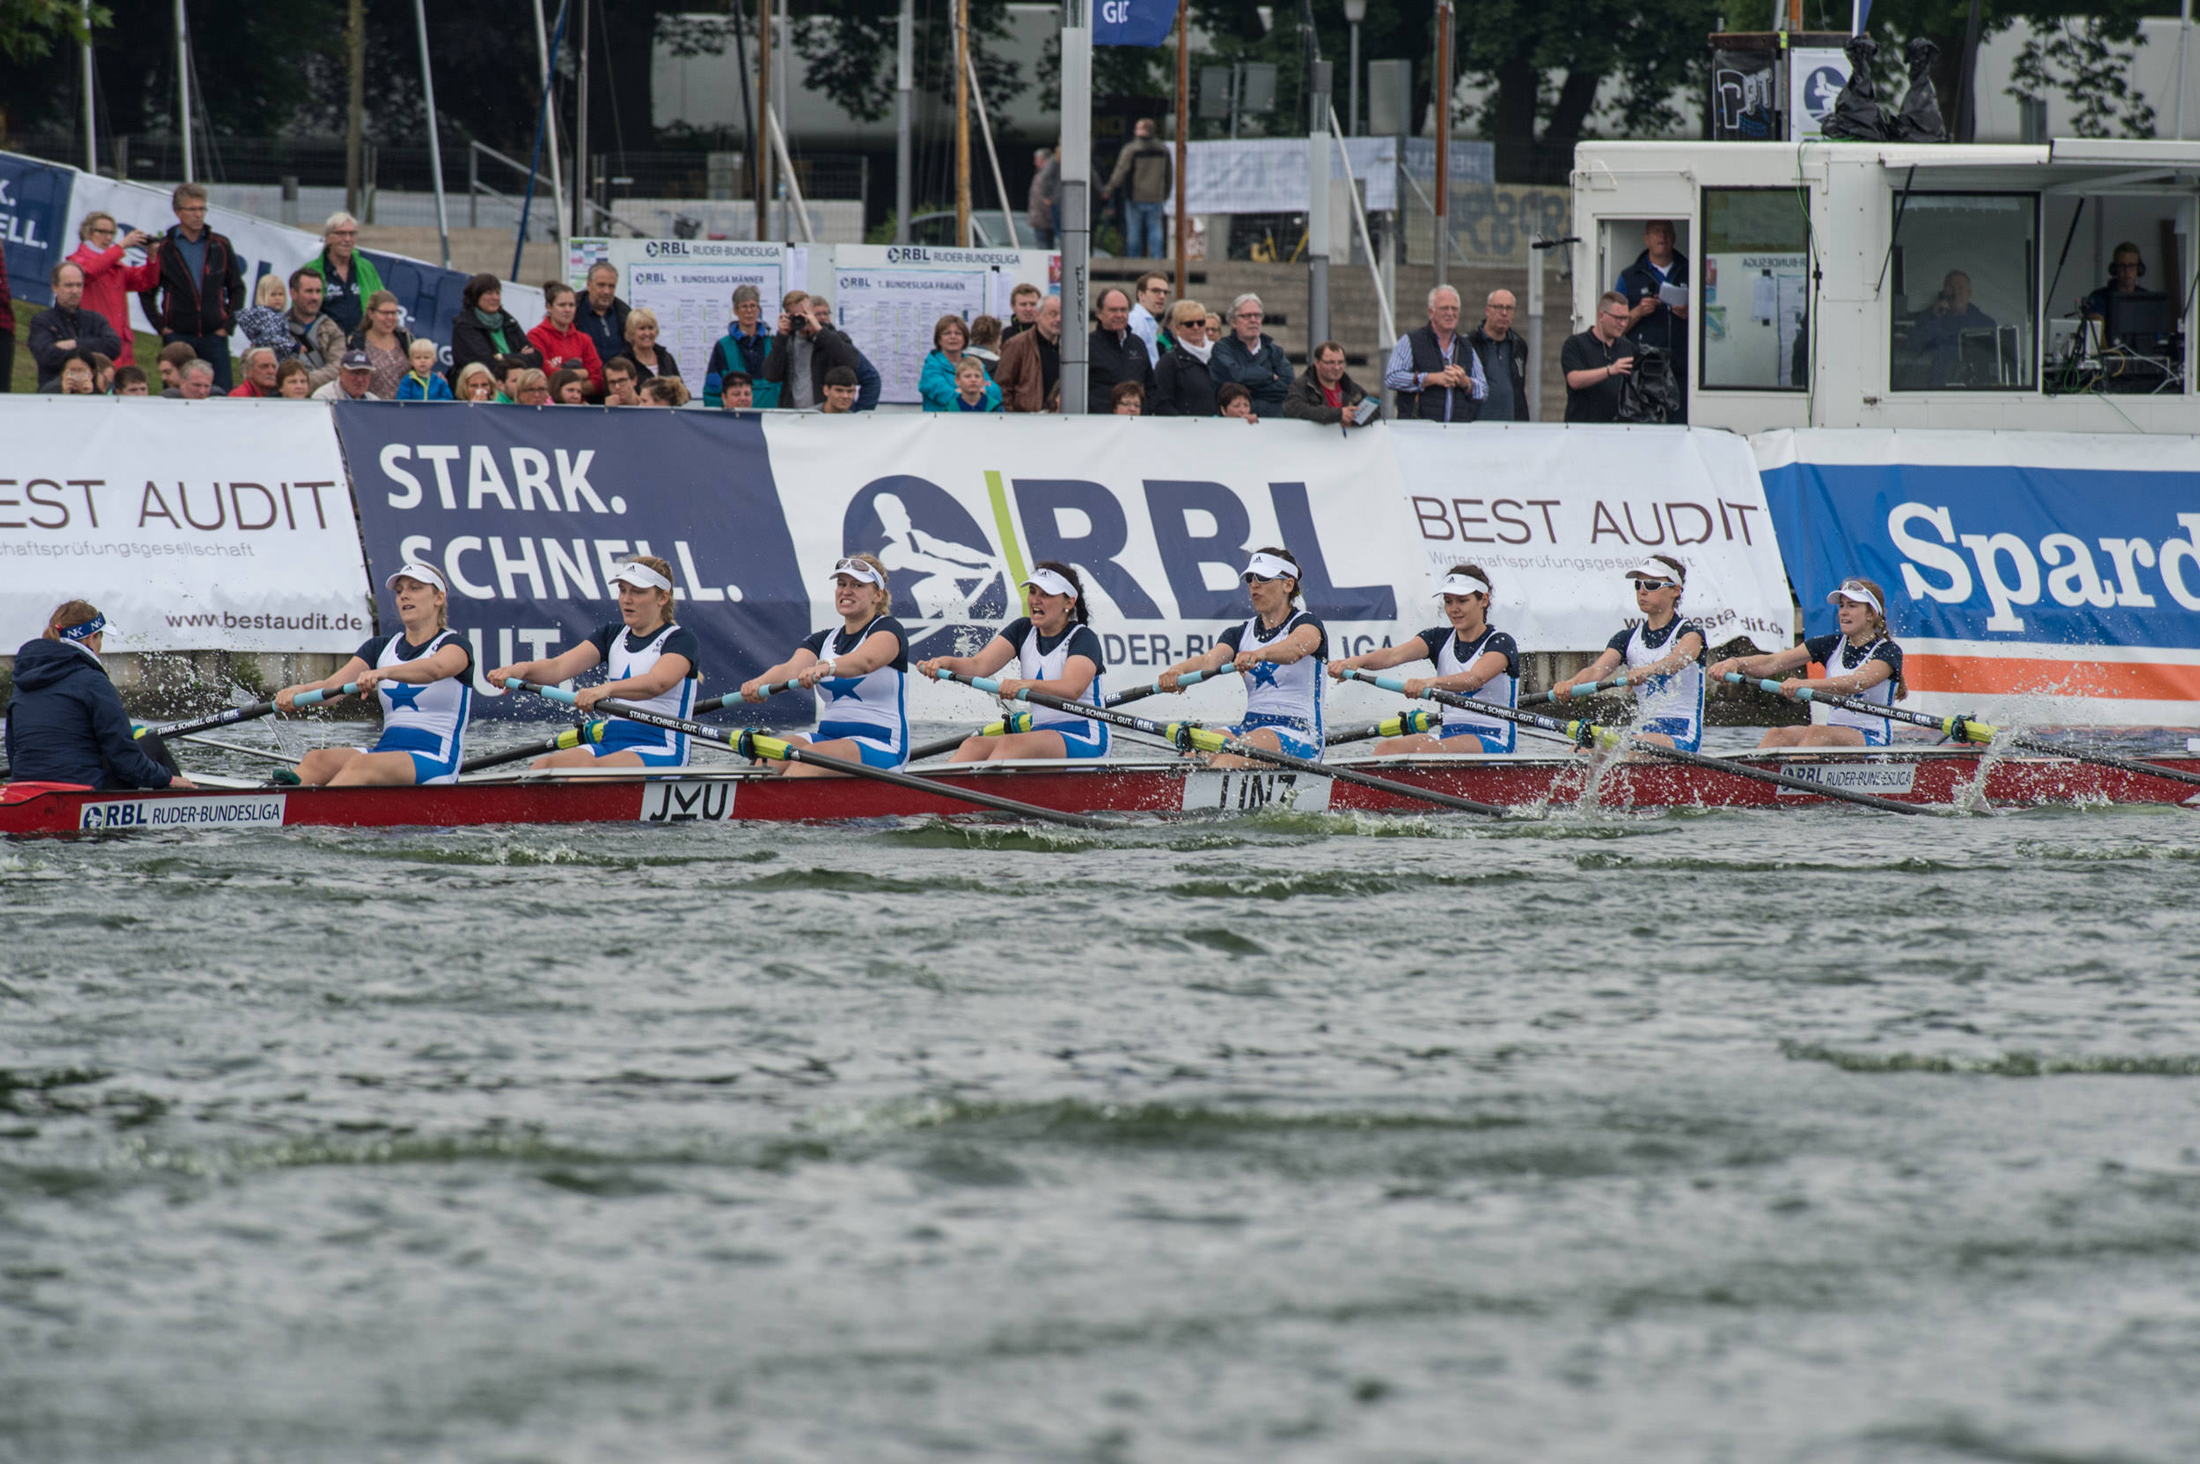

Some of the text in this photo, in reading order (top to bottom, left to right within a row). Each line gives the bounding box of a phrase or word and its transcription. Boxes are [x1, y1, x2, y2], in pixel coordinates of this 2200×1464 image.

[660, 242, 780, 257] RBL RUDER-BUNDESLIGA
[902, 248, 1020, 265] RBL RUDER-BUNDESLIGA
[646, 273, 667, 283] RBL
[681, 275, 730, 284] BUNDESLIGA
[731, 274, 764, 284] MÄNNER
[850, 277, 871, 288] RBL
[885, 280, 934, 290] BUNDESLIGA
[935, 281, 965, 291] FRAUEN
[379, 443, 627, 515] STARK.
[138, 480, 336, 531] AUDIT
[1411, 496, 1758, 547] BEST AUDIT
[0, 542, 255, 559] haftsprüfungsgesellschaft
[1012, 479, 1397, 621] RBL
[1887, 501, 2200, 632] Spard
[67, 626, 83, 640] NK
[165, 611, 363, 631] www.bestaudit.de
[468, 628, 574, 697] UT.
[157, 709, 239, 735] STARK. SCHNELL. GUT. RBL
[629, 710, 719, 737] STARK. SCHNELL. GUT. RBL
[1062, 702, 1155, 730] STARK. SCHNELL. GUT. RBL
[1465, 700, 1555, 727] STARK. SCHNELL. GUT. RBL
[1915, 713, 1931, 724] RBL
[1796, 767, 1823, 784] RBL
[106, 803, 280, 827] RBL RUDER-BUNDESLIGA
